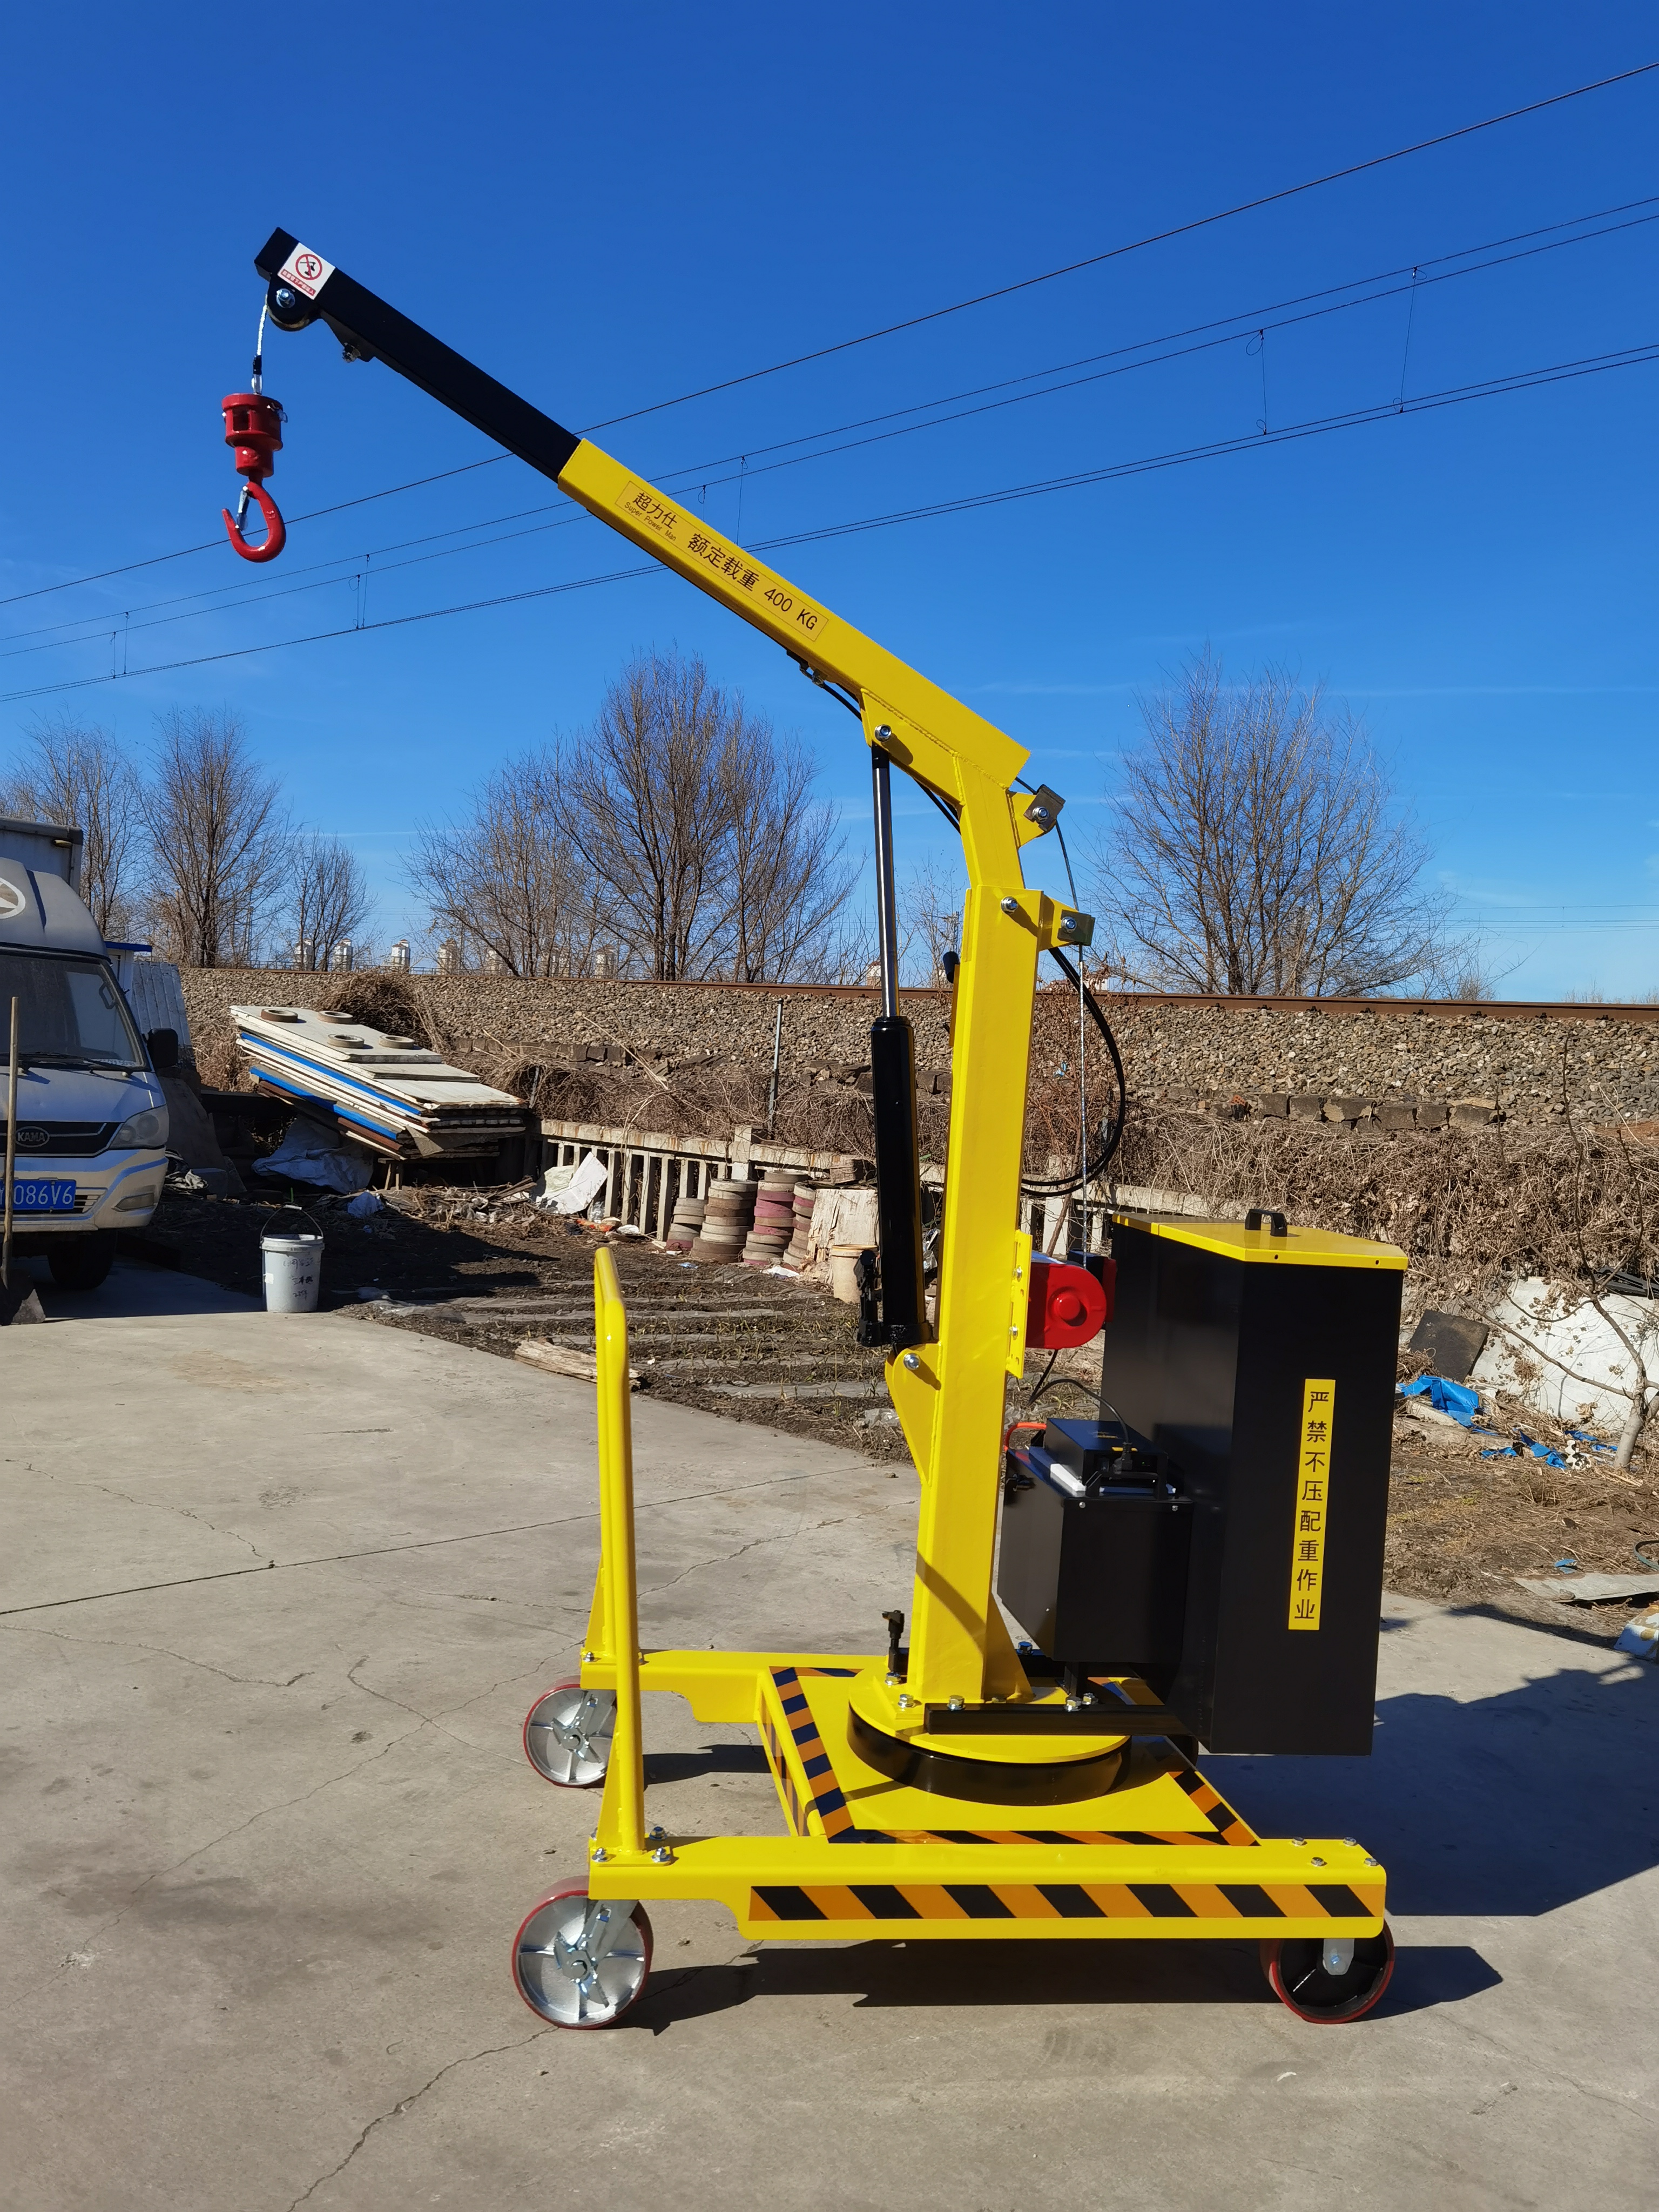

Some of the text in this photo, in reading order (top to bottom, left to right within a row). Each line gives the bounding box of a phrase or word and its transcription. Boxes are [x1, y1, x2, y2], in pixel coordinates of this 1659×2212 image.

[624, 502, 677, 542] Super Power Man
[632, 493, 677, 529] 超力仕
[687, 533, 818, 631] 额定载重 400 KG
[17, 1132, 45, 1142] KAMA
[1294, 1391, 1330, 1620] 严禁不压配重作业
